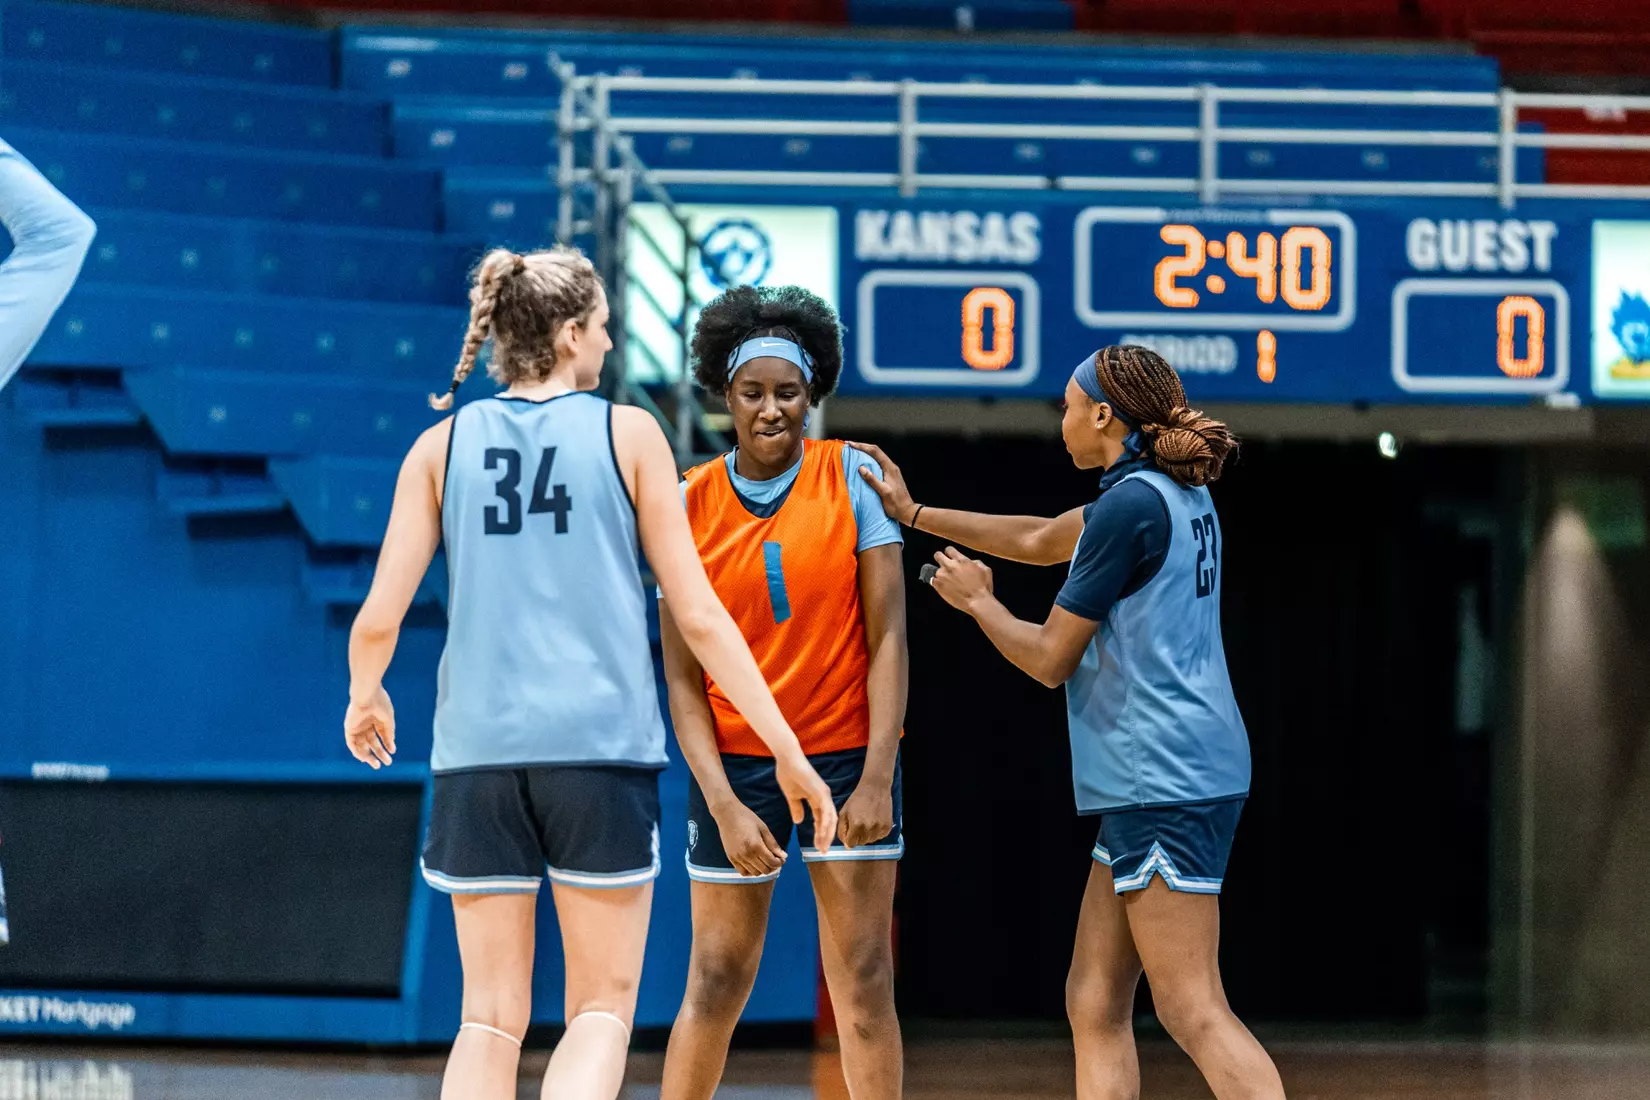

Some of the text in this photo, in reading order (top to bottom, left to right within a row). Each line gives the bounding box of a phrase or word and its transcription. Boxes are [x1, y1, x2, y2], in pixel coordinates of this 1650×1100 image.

[855, 210, 1041, 264] KANSAS
[1154, 224, 1332, 311] 2:40
[1406, 218, 1558, 273] GUEST
[961, 287, 1015, 371] 0
[1119, 334, 1238, 374] RIOD
[1257, 329, 1277, 383] 1
[1496, 295, 1545, 379] 0
[484, 446, 572, 535] 34
[1190, 512, 1218, 599] 23
[40, 996, 136, 1031] Mortgage
